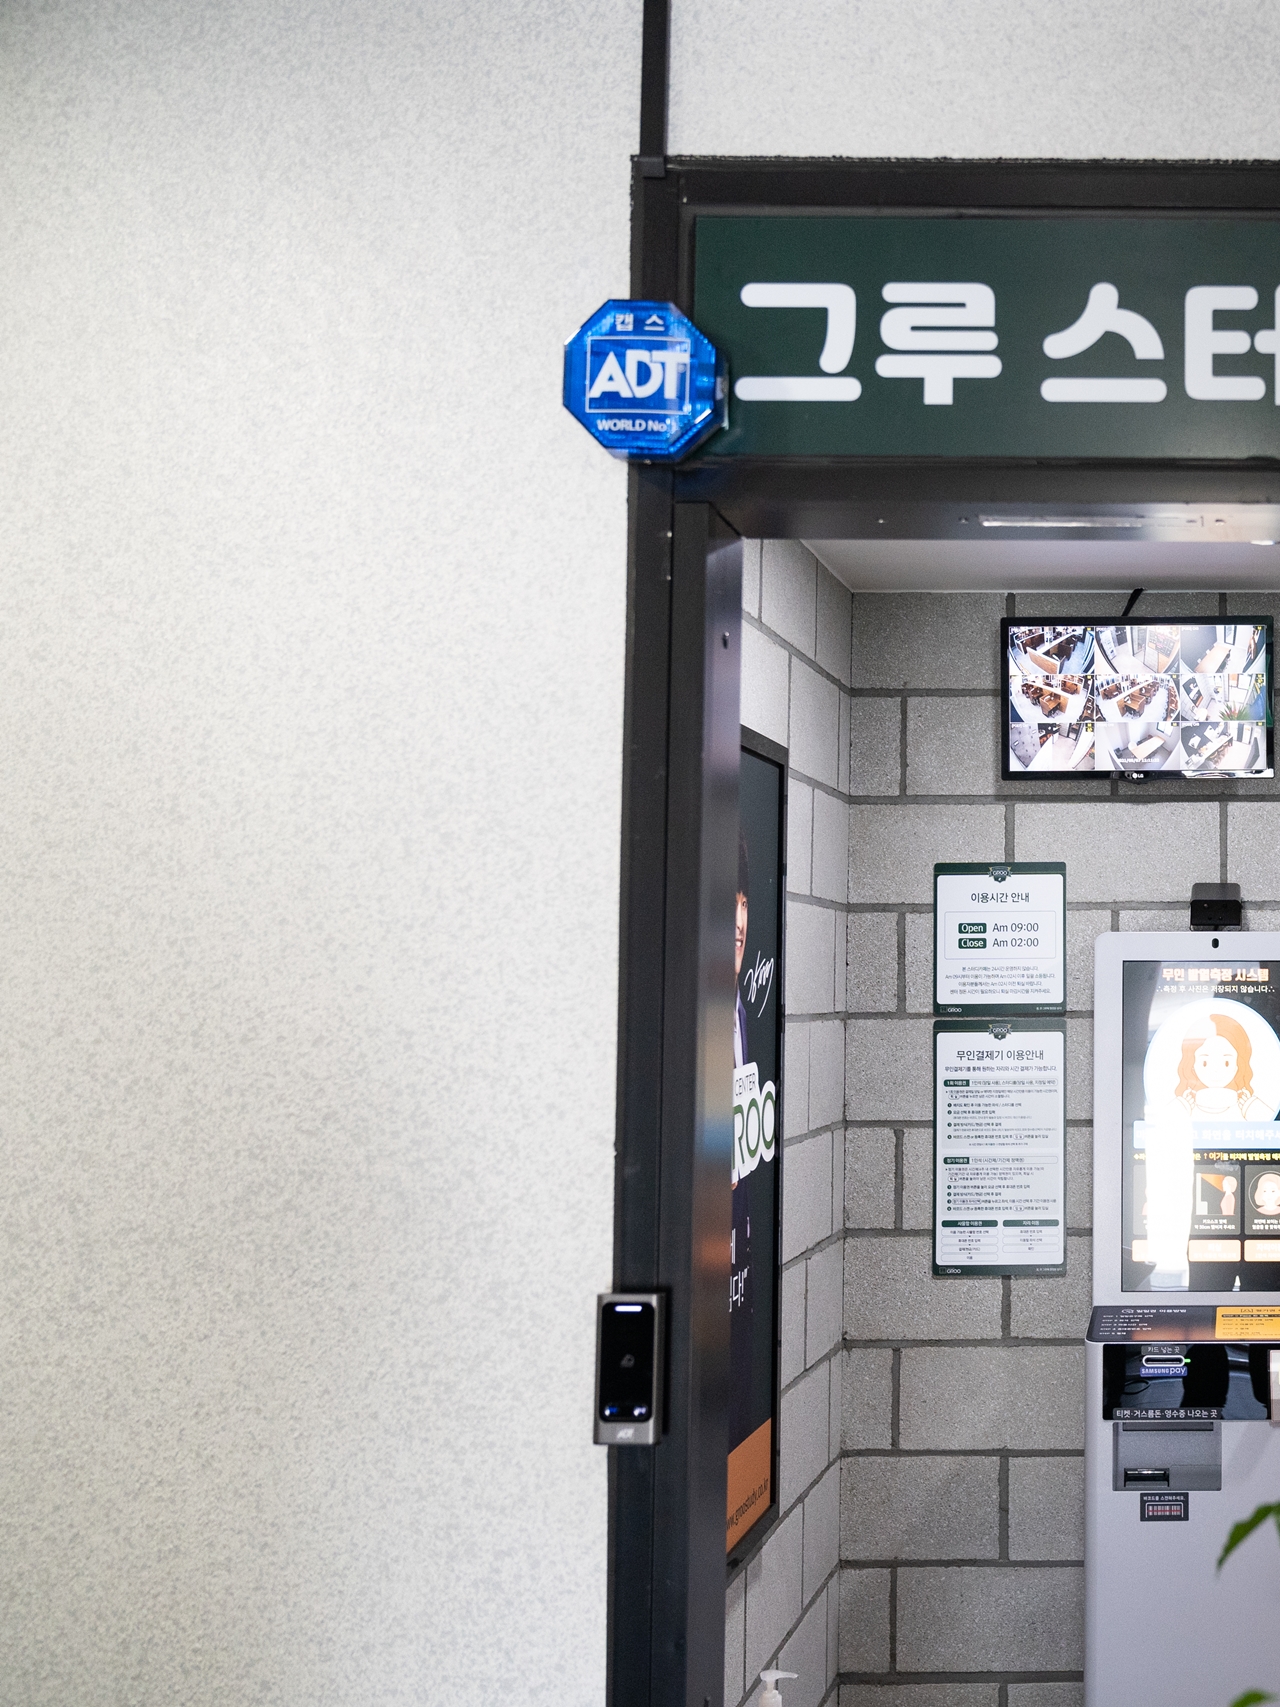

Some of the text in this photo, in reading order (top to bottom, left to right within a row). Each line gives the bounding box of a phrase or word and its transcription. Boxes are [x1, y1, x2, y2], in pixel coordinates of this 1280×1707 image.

[734, 282, 1002, 404] 그루
[589, 349, 689, 399] ADT
[597, 420, 646, 432] WORLD
[971, 892, 1030, 903] 이용시간 안내
[961, 922, 1039, 933] Open Am 09:00
[961, 937, 1039, 948] Close Am 02:00
[1162, 968, 1269, 982] 무인 발열측정 시스템
[1179, 985, 1186, 994] 후
[1188, 985, 1209, 994] 사진은
[1211, 985, 1238, 994] 저장되지
[956, 1050, 1044, 1061] 무인결제기 이용안내
[735, 1072, 756, 1096] CENTER
[1187, 1409, 1209, 1419] 나오는
[1210, 1409, 1218, 1419] 곳
